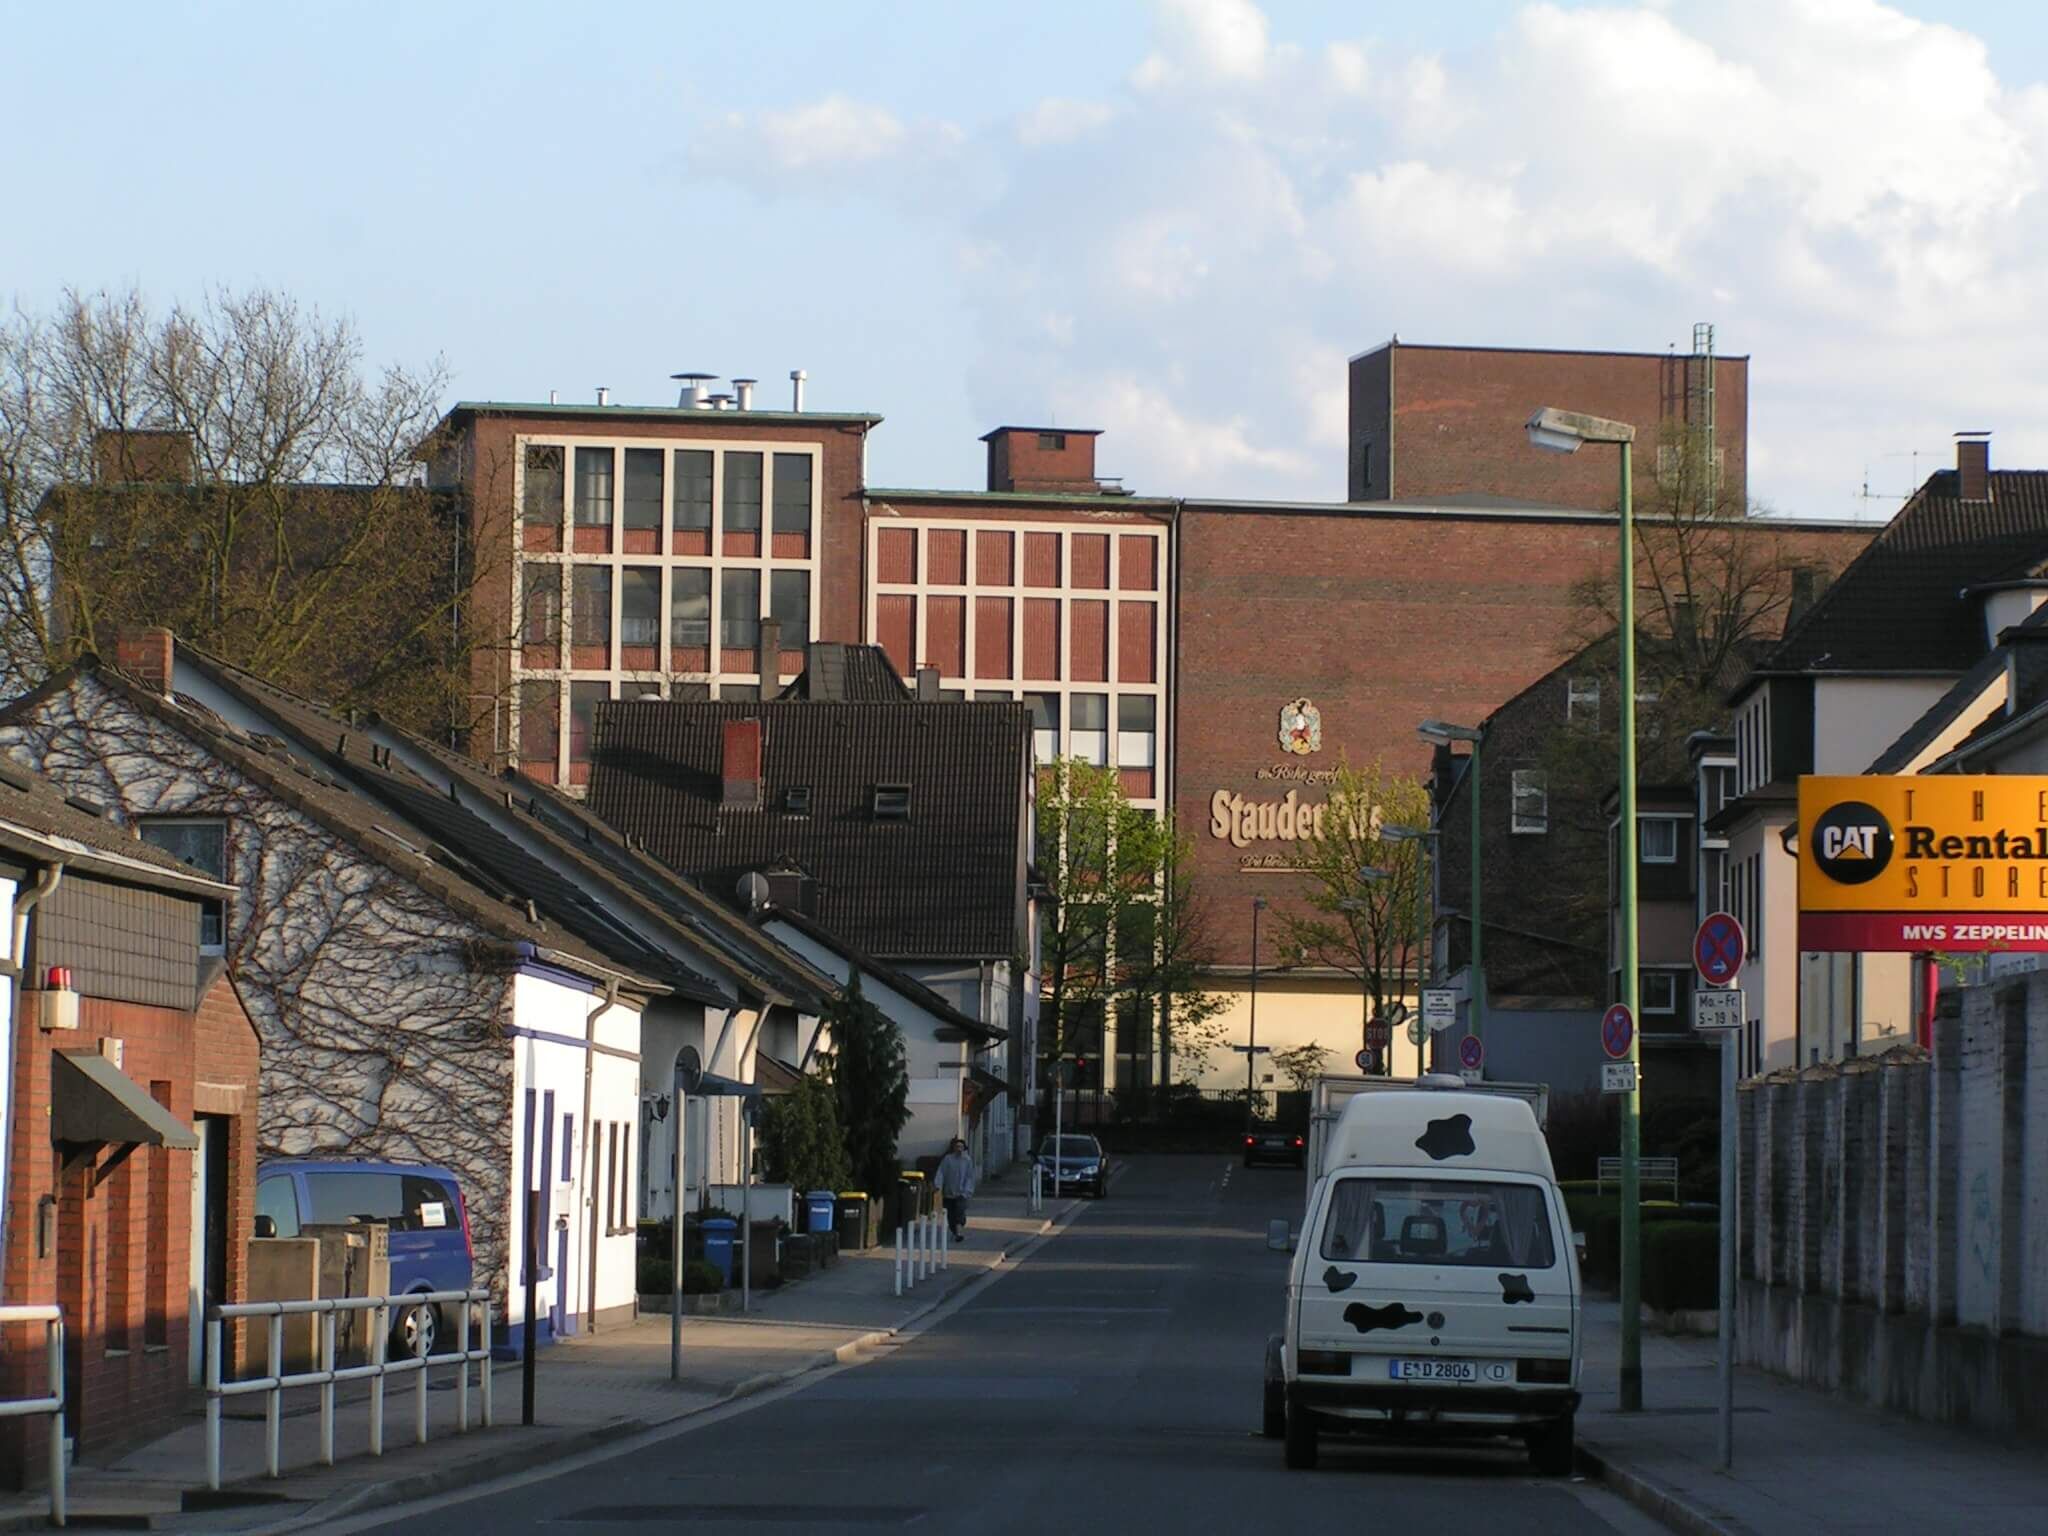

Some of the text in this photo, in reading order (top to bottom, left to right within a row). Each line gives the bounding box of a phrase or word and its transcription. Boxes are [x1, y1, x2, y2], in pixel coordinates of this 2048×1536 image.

[1210, 788, 1328, 848] Stauder
[1823, 825, 1879, 860] CAT
[1904, 826, 2048, 860] Rental
[1904, 865, 2048, 898] STORE
[1902, 925, 2048, 941] MVS ZEPPELIN
[1403, 1362, 1413, 1377] E
[1435, 1363, 1471, 1378] 2806
[1493, 1365, 1505, 1379] D
